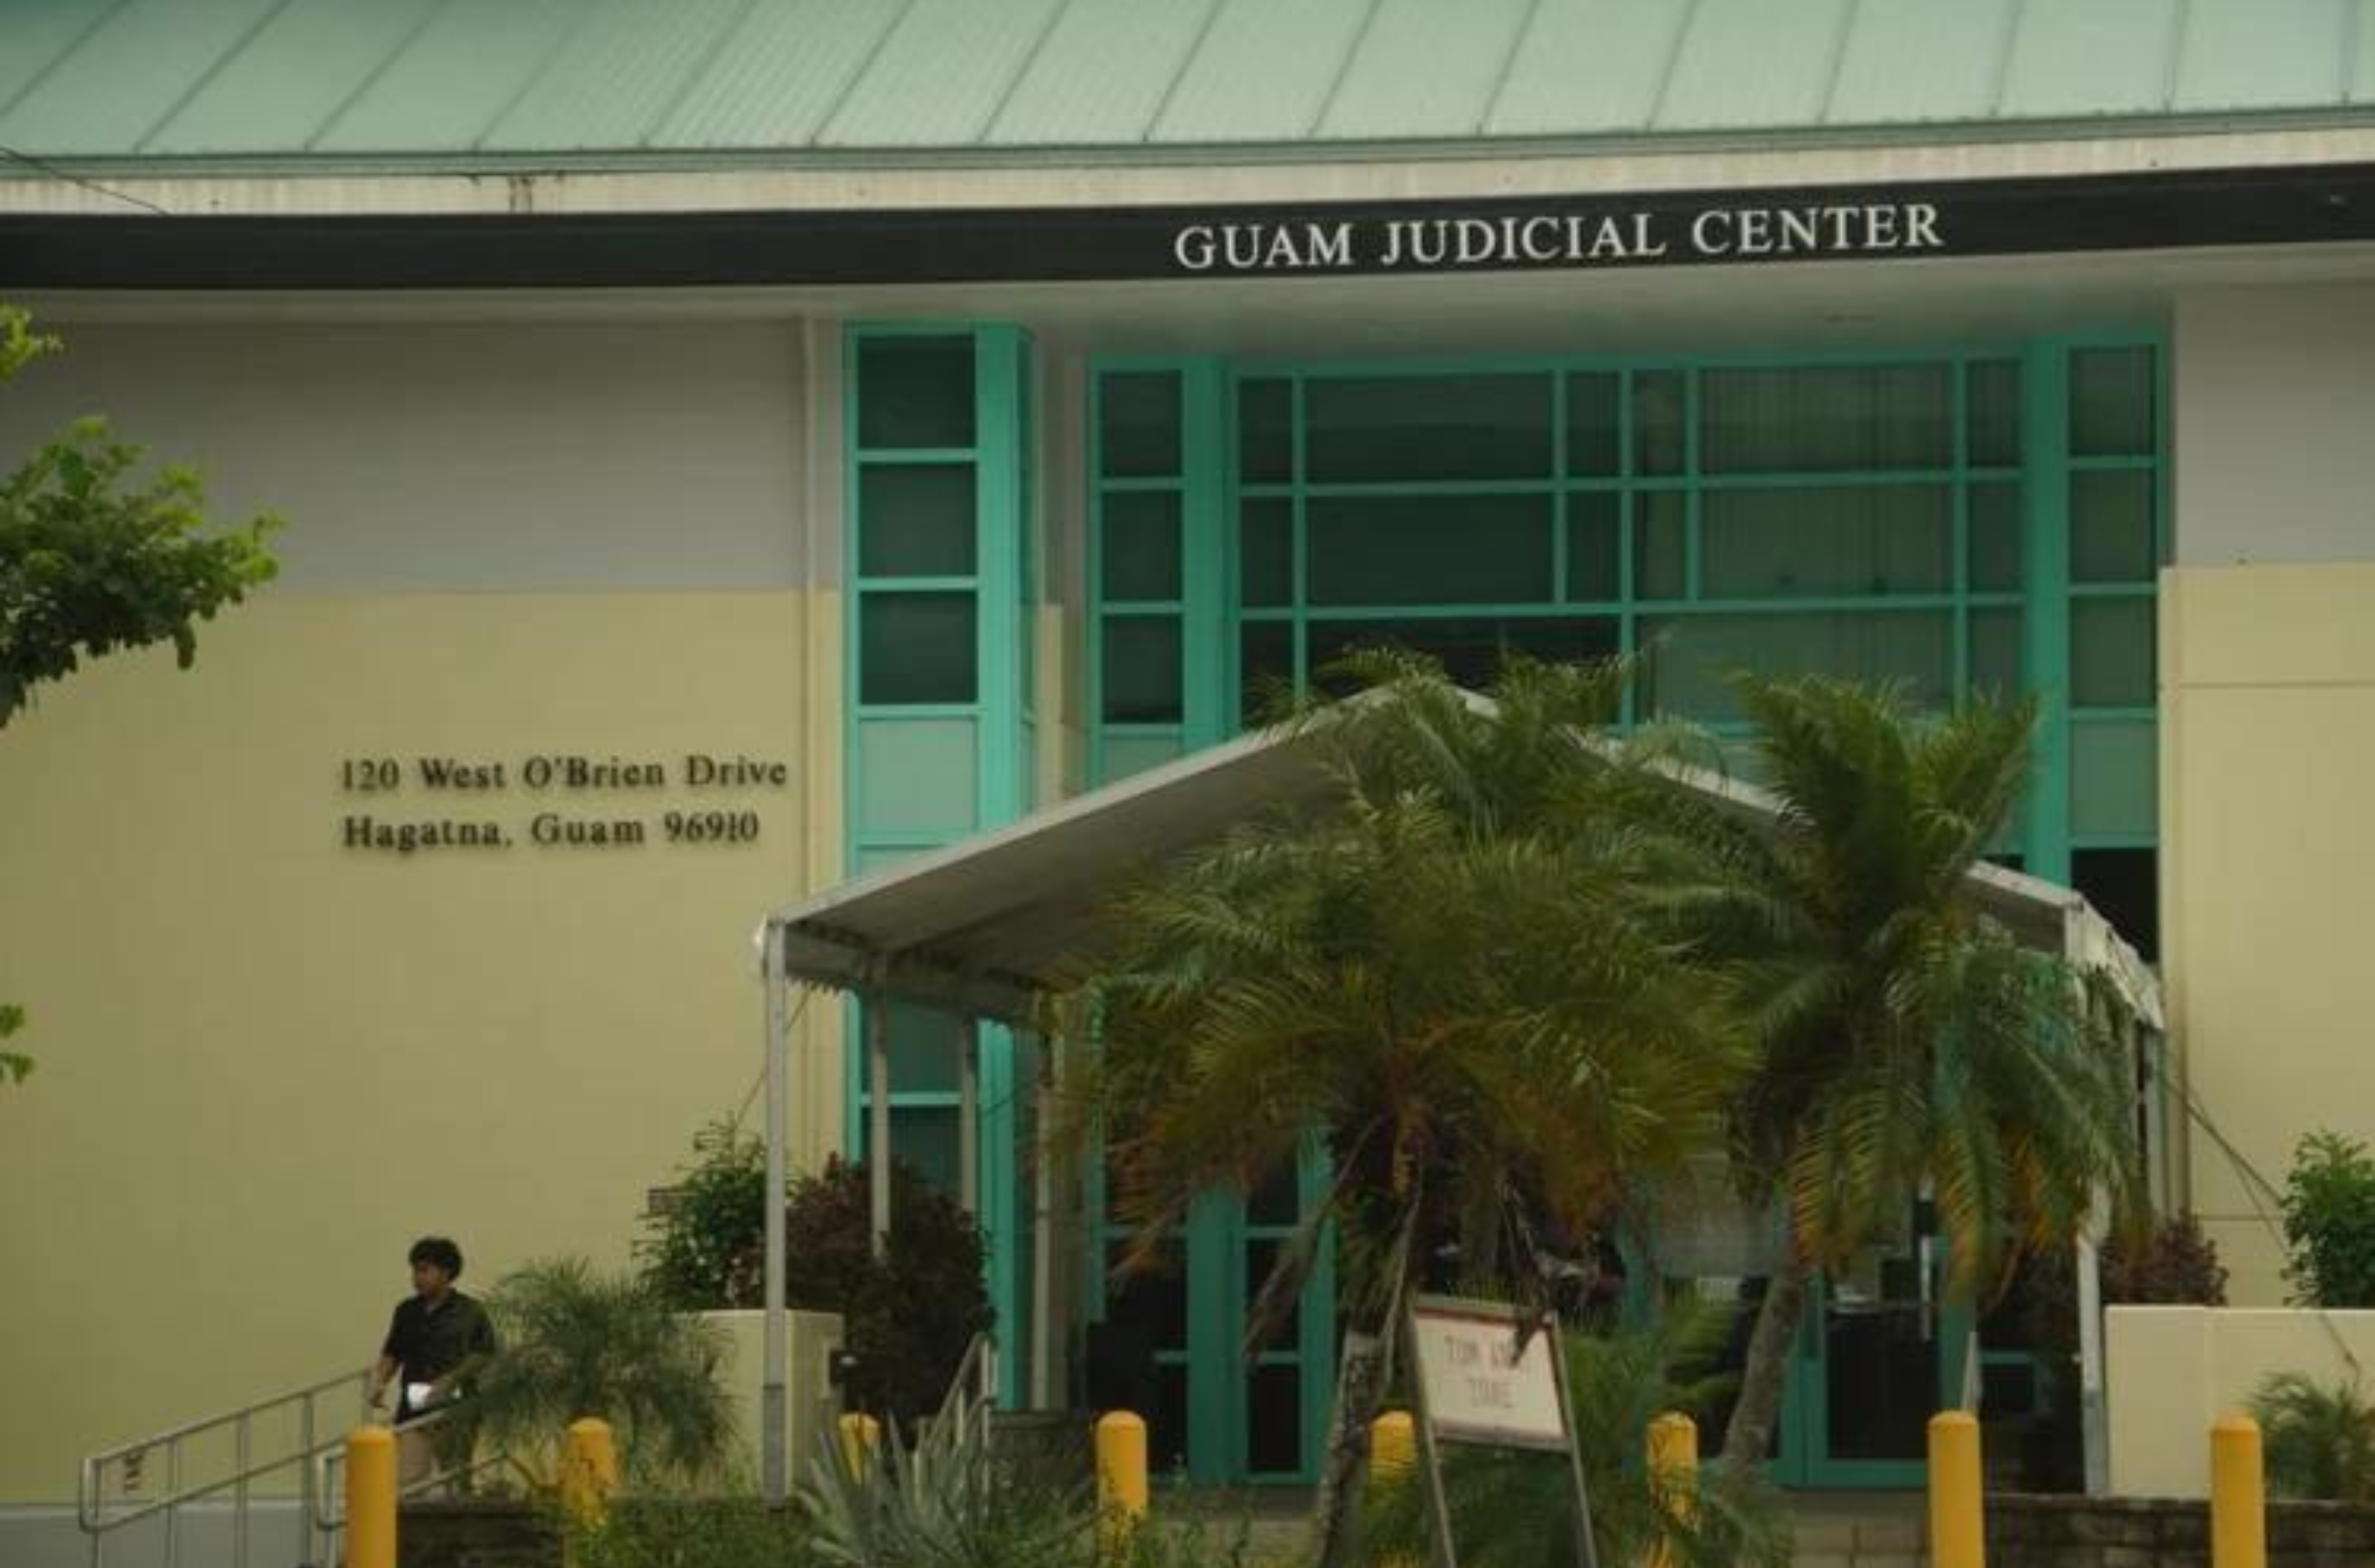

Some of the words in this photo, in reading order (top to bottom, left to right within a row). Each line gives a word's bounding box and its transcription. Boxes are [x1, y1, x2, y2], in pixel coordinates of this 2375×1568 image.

[1174, 221, 1355, 270] GUAM
[1379, 214, 1667, 265] JUDICIAL
[1691, 203, 1945, 254] CENTER
[343, 757, 401, 790] 120
[418, 757, 505, 789] West
[523, 756, 665, 788] O'Brien
[685, 754, 787, 785] Drive
[530, 813, 645, 843] Guam
[664, 810, 760, 842] 96910
